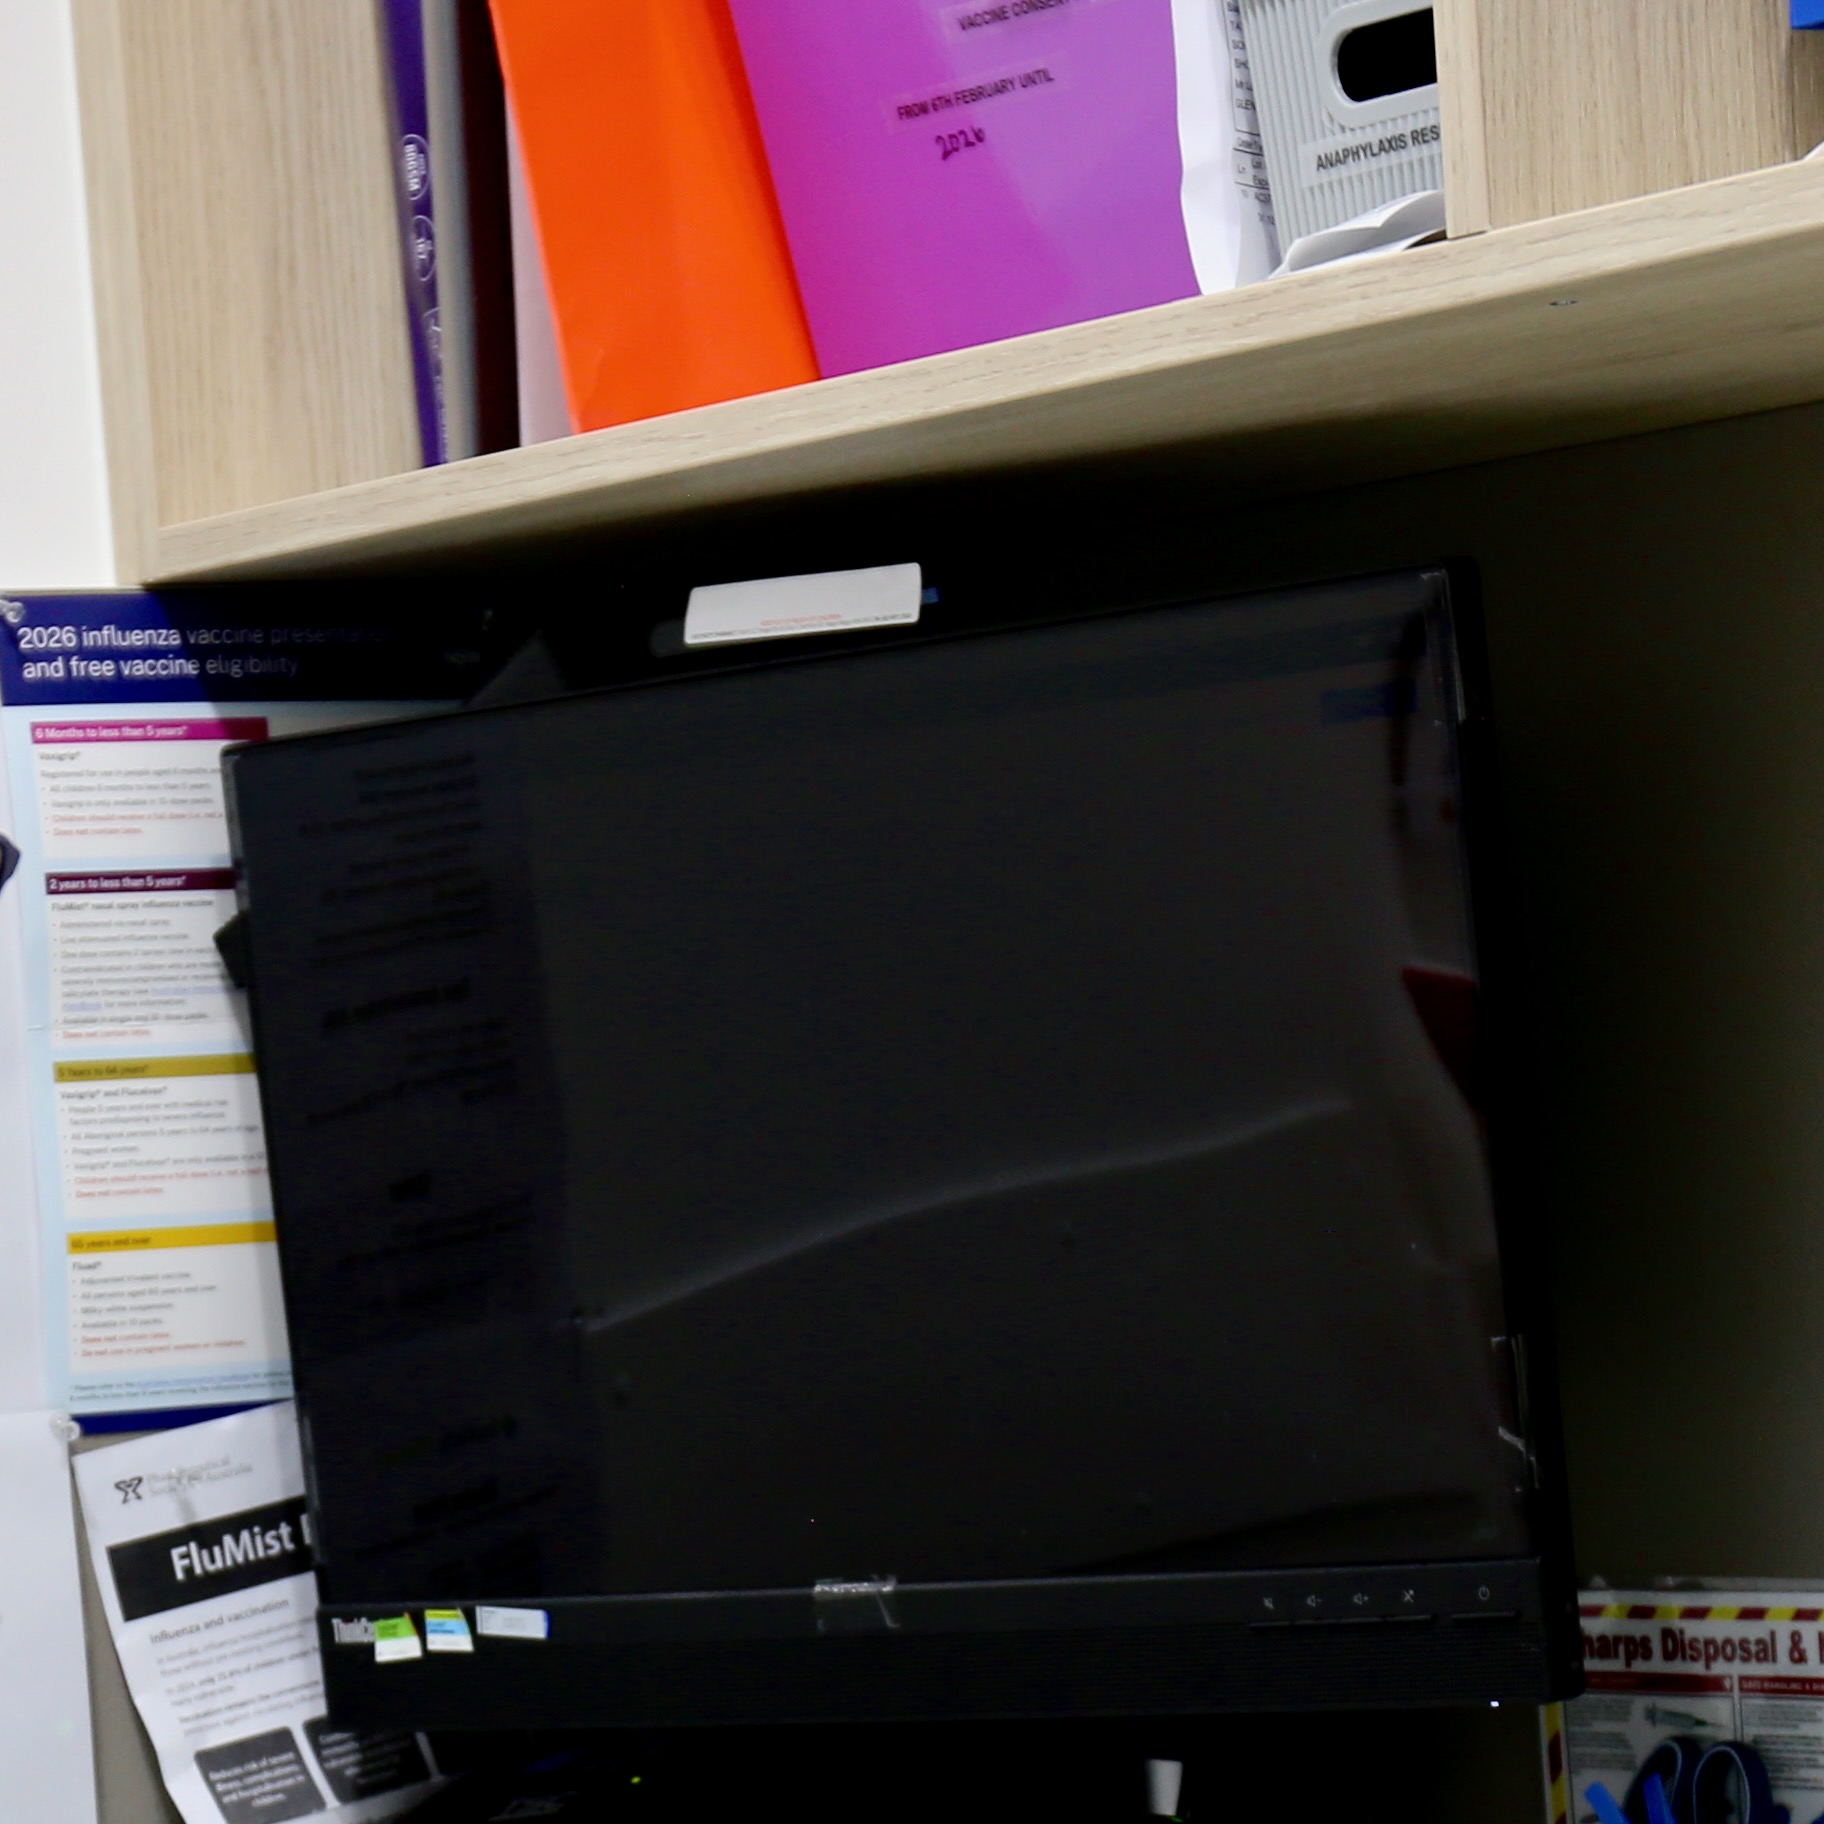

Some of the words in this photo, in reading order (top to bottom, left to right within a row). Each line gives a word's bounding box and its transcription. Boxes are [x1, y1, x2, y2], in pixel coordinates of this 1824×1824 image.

[957, 6, 1009, 31] VACCINE
[897, 95, 928, 121] FROM
[954, 78, 1015, 108] FEBRUARY
[1019, 68, 1055, 89] UNTIL
[1316, 133, 1408, 172] ANAPHYLAXIS
[17, 626, 77, 650] 2026
[81, 624, 182, 647] influenza
[186, 625, 266, 646] vaccine
[22, 656, 64, 679] and
[69, 654, 115, 677] free
[119, 653, 200, 677] vaccine
[205, 652, 298, 680] eligibility
[45, 726, 84, 738] Months
[86, 726, 97, 737] to
[99, 725, 120, 737] less
[122, 725, 145, 736] than
[146, 725, 155, 736] 5
[50, 879, 57, 889] 2
[59, 879, 86, 890] years
[88, 878, 99, 888] to
[100, 878, 120, 887] less
[122, 877, 145, 887] than
[146, 877, 154, 886] 5
[170, 1520, 296, 1582] FluMist
[204, 1615, 224, 1629] and
[227, 1599, 289, 1623] vaccination
[1579, 1629, 1654, 1668] harps
[1659, 1626, 1777, 1669] Disposal
[1788, 1628, 1808, 1665] &
